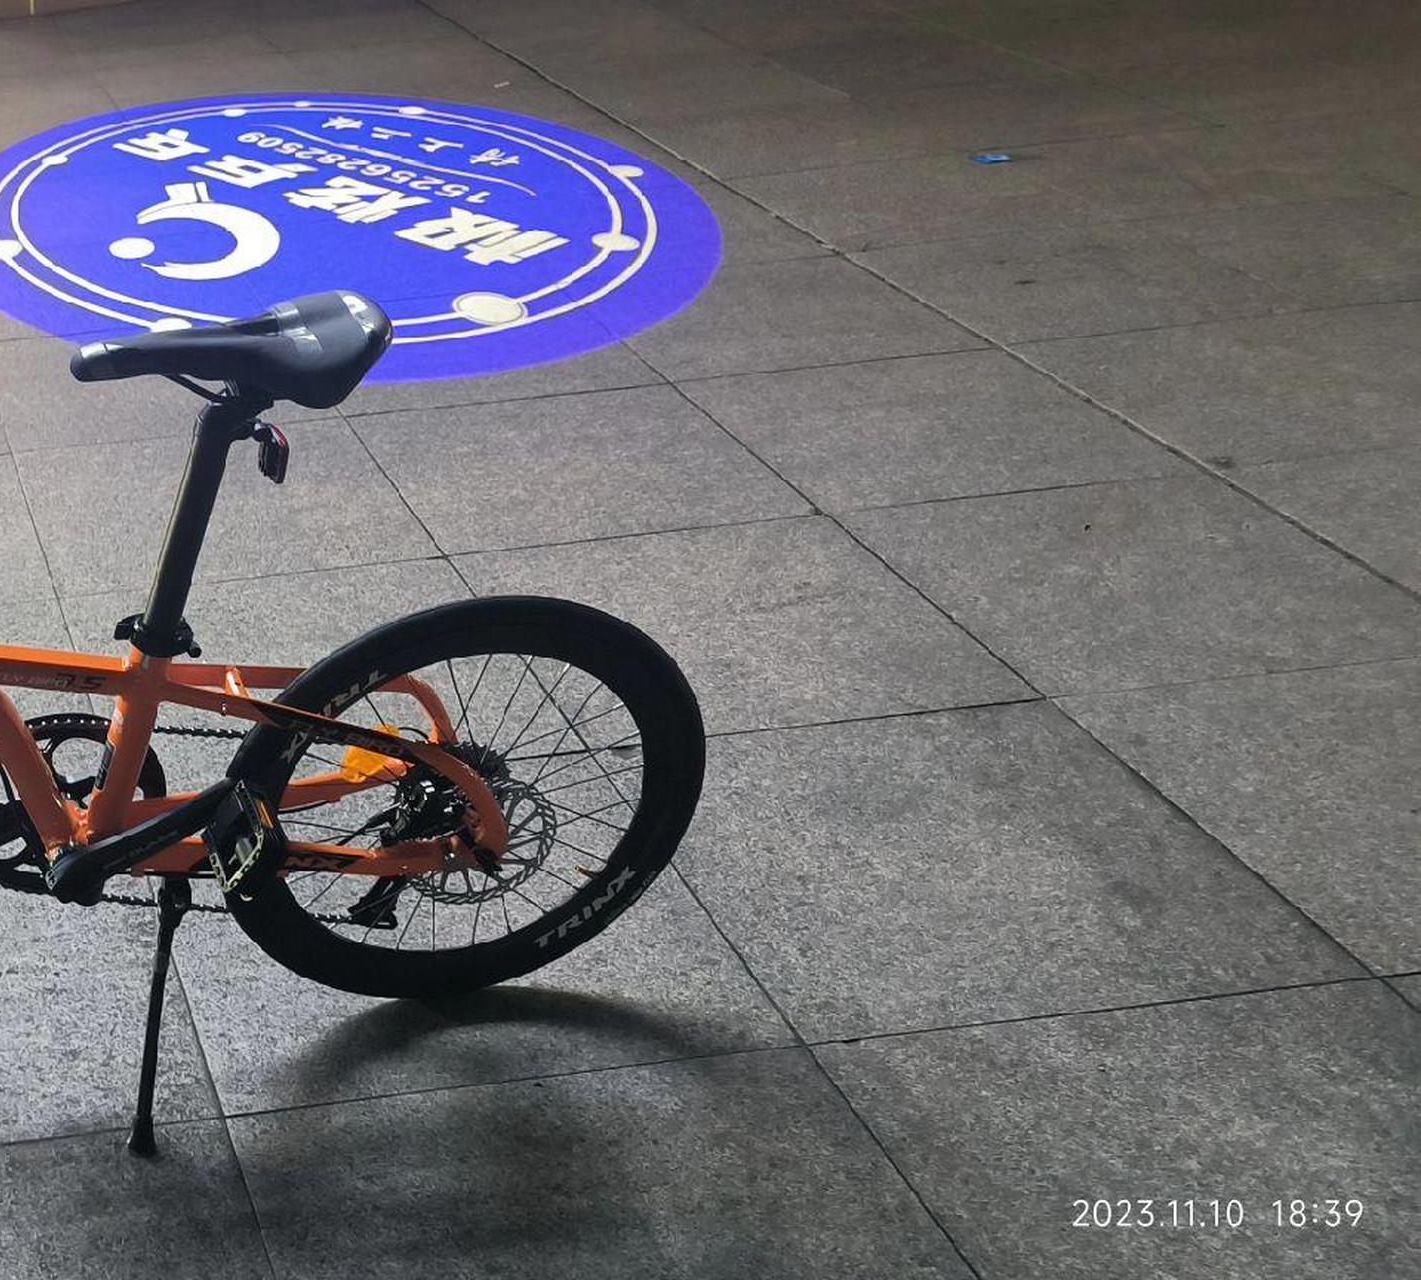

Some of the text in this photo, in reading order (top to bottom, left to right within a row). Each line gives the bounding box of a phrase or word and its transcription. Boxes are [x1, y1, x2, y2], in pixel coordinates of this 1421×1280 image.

[112, 128, 572, 266] 极炫乒乓
[236, 131, 491, 204] 15256282509
[534, 866, 638, 949] TRINX
